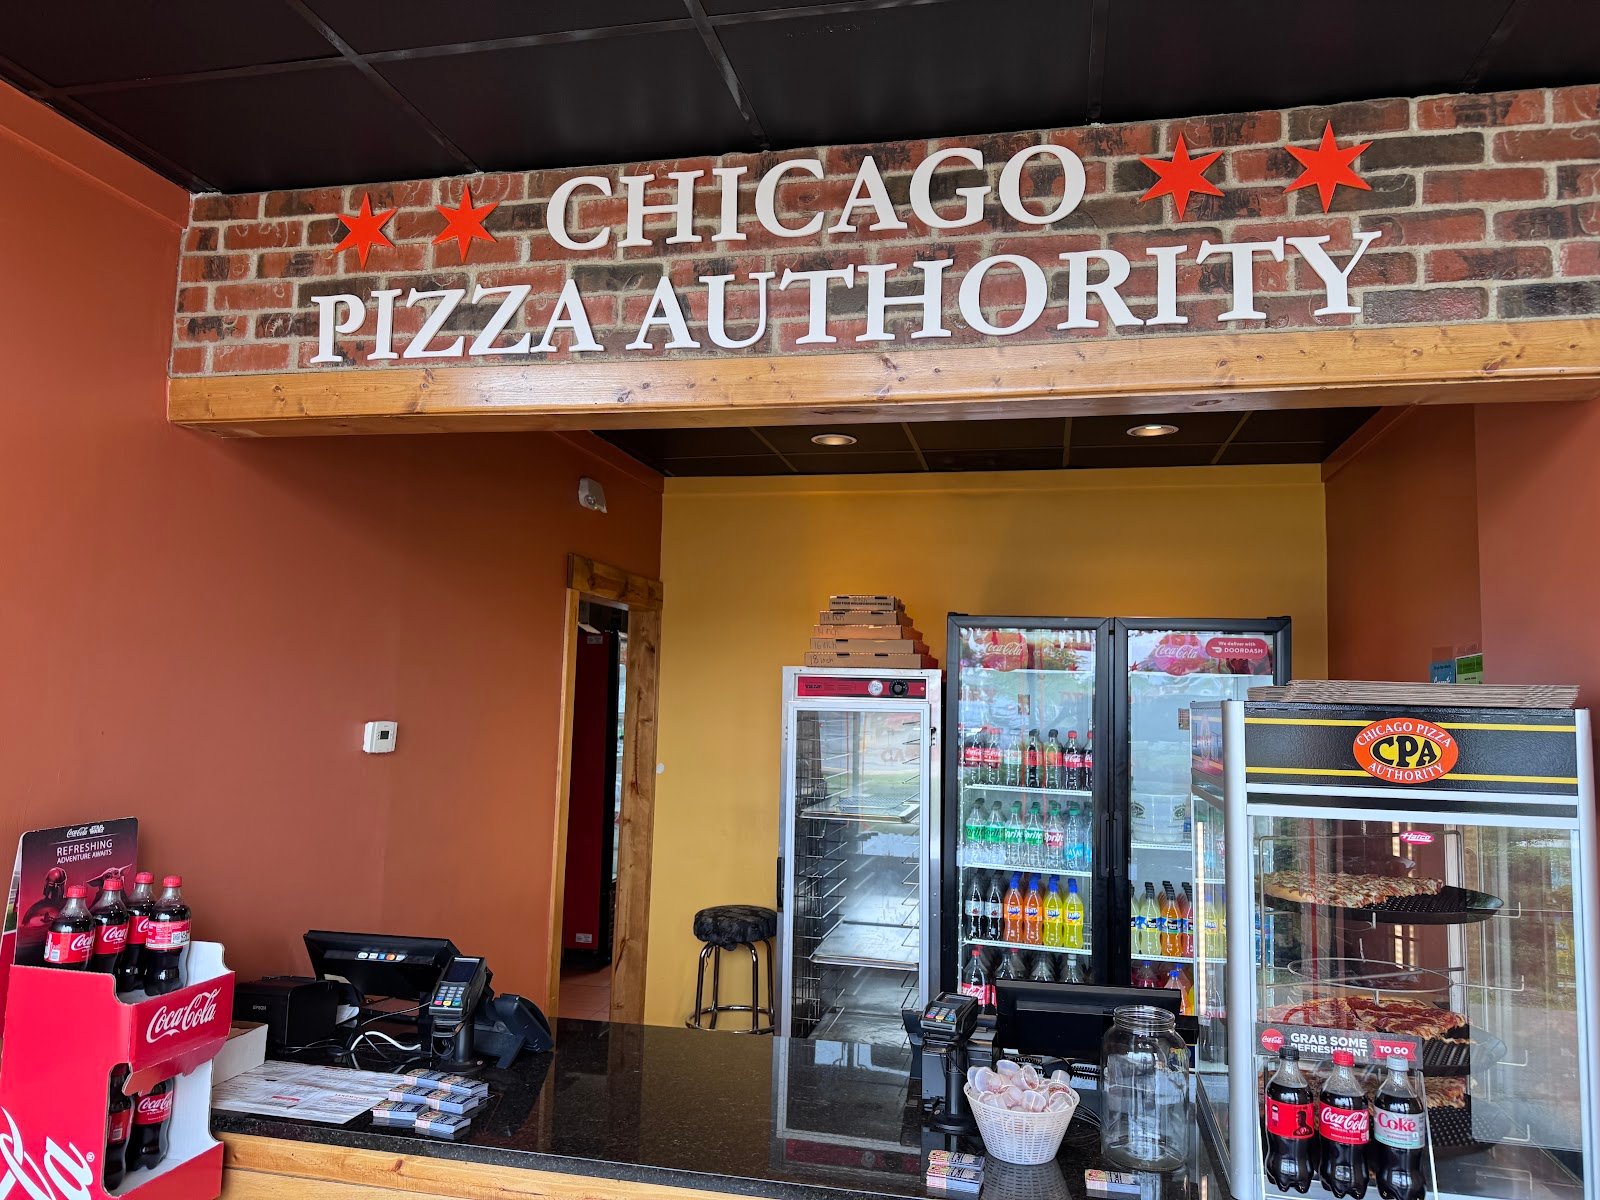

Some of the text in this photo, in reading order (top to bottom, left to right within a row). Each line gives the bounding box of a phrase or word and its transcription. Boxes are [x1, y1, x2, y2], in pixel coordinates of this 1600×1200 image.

[546, 144, 1087, 252] CHICAGO
[309, 230, 1383, 365] PIZZA AUTHORITY
[985, 642, 1023, 656] Coca-Cola
[1154, 644, 1198, 659] Coca-Cola
[1356, 722, 1451, 748] CHICAGO PIZZA
[1372, 735, 1438, 767] CPA
[1367, 762, 1444, 781] AUTHORITY
[56, 839, 113, 857] REFRESHING
[56, 849, 113, 864] ADVENTURE AWAITS
[146, 987, 222, 1043] Coca-Cola
[1261, 1035, 1284, 1044] Coca-Cola
[1290, 1033, 1368, 1049] GRAB SOME
[1378, 1045, 1409, 1056] TO GO
[1320, 1106, 1369, 1131] Coca-Cola
[1377, 1112, 1416, 1132] Coke
